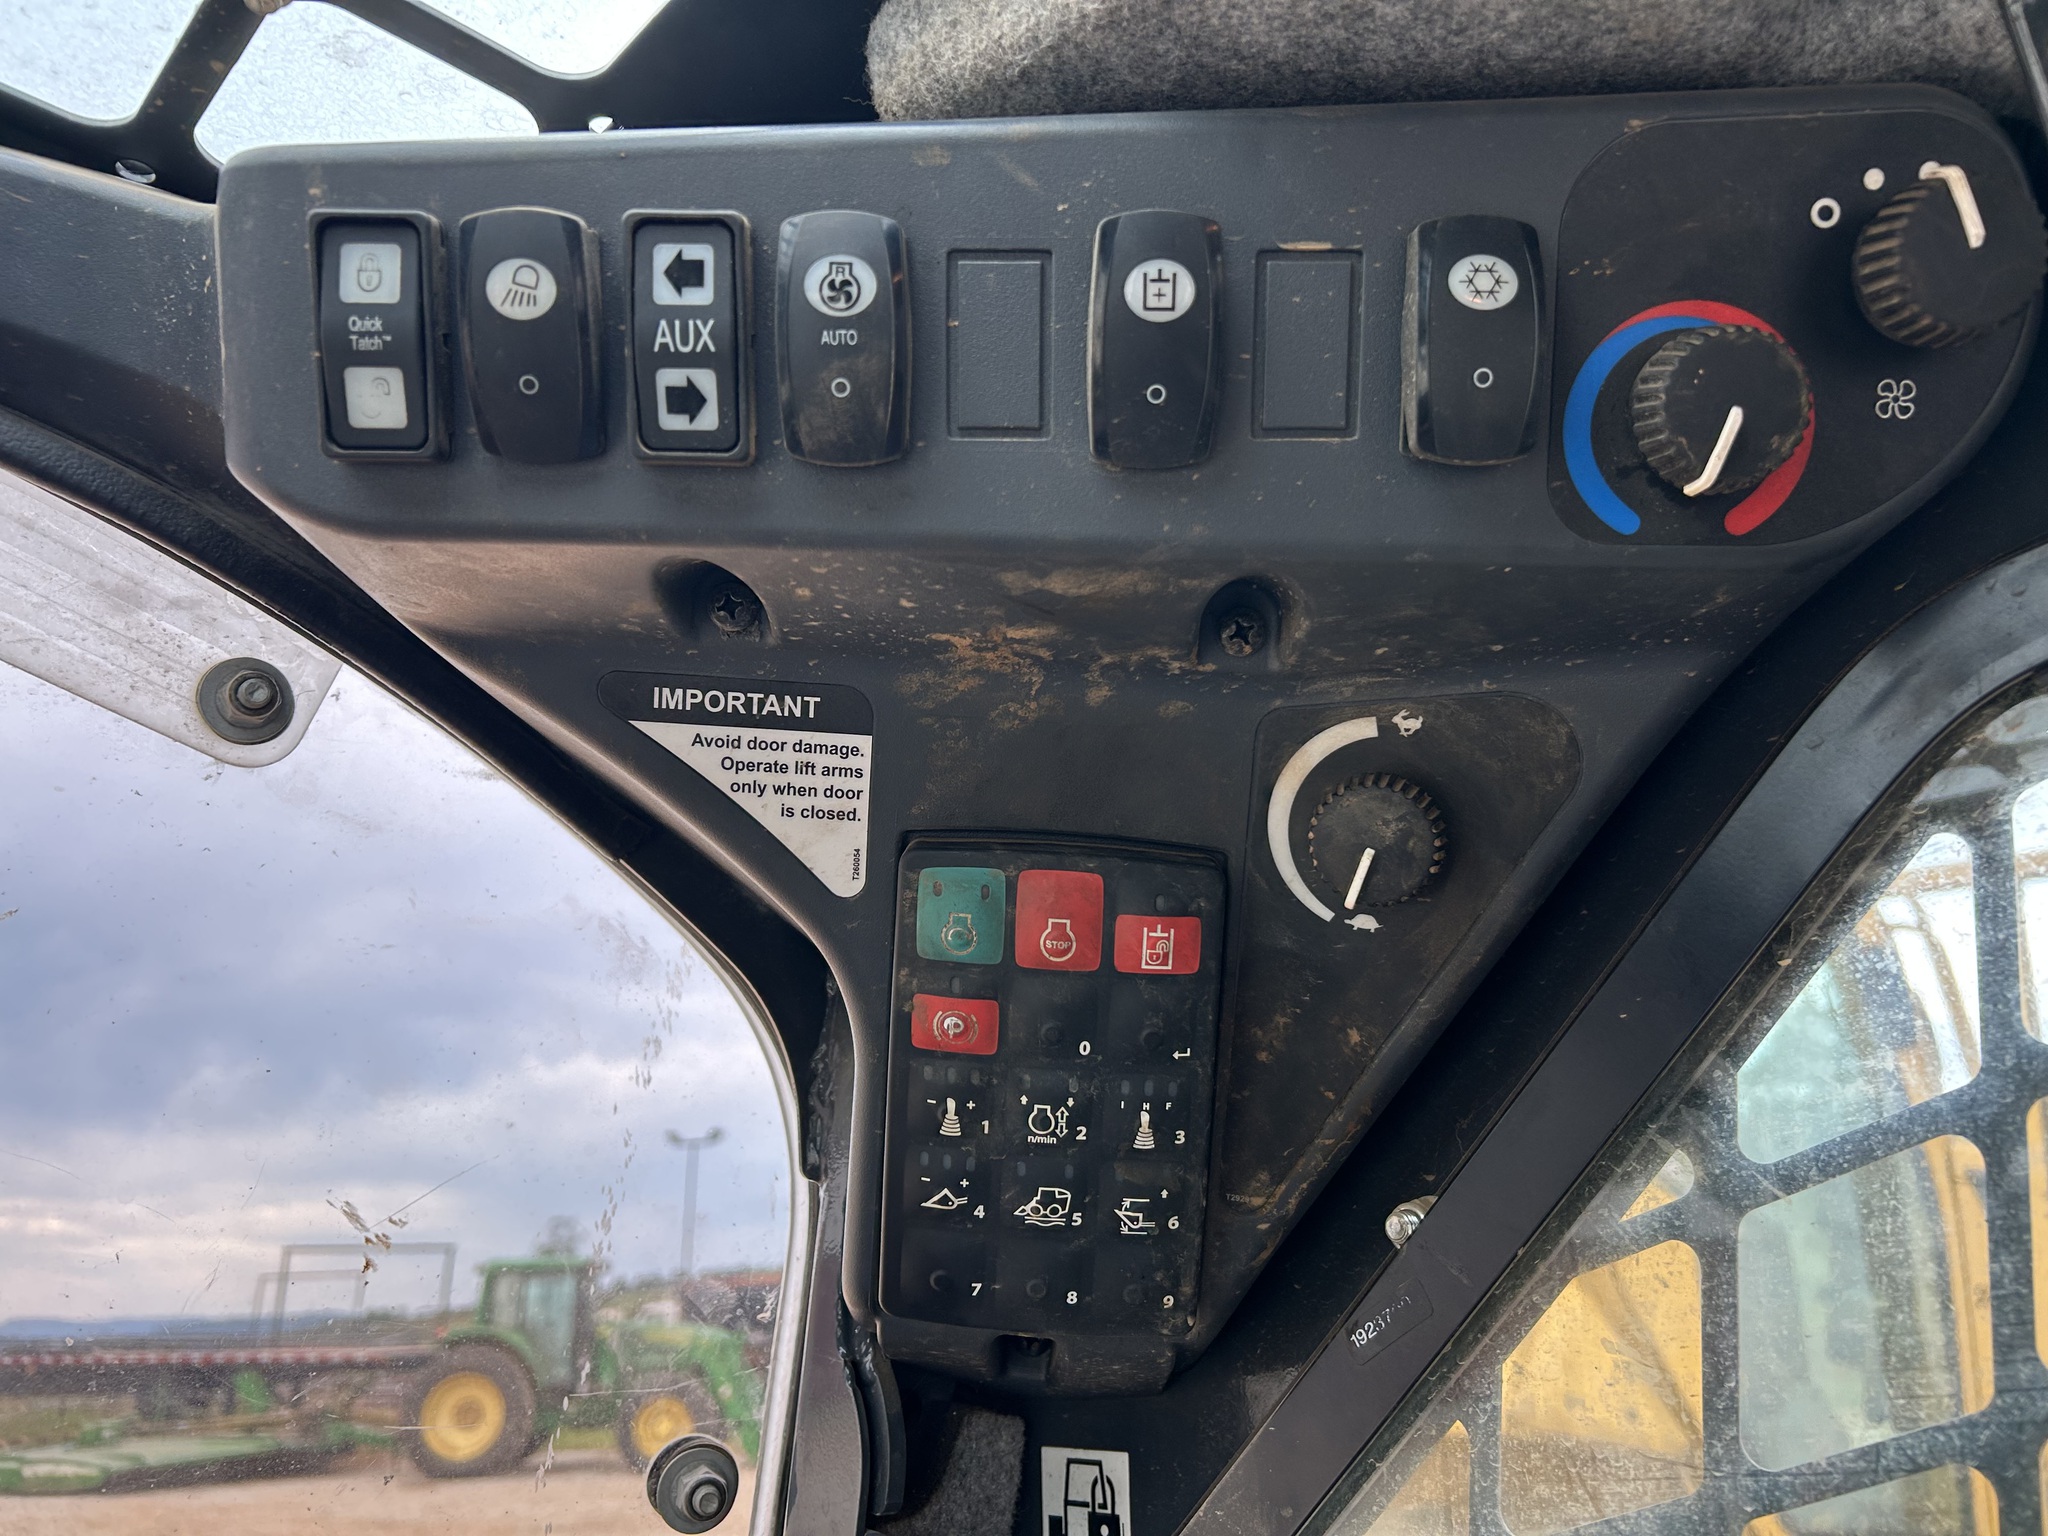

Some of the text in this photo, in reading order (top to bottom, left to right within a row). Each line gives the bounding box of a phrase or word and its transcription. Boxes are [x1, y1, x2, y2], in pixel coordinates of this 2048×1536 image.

[348, 315, 383, 332] Quick
[653, 319, 716, 353] AUX
[820, 329, 858, 346] AUTO
[652, 686, 821, 719] IMPORTANT
[690, 732, 865, 760] Avoid door damage.
[720, 756, 864, 779] Operate lift arms
[730, 780, 864, 801] only when door
[780, 804, 862, 823] is closed.
[852, 848, 861, 881] T260054
[1045, 939, 1072, 950] STOP
[1079, 1041, 1091, 1056] 0
[1142, 1102, 1150, 1111] H
[1165, 1102, 1172, 1111] F
[981, 1120, 989, 1134] 1
[1075, 1126, 1087, 1141] 2
[1027, 1134, 1057, 1145] n/min
[1174, 1130, 1186, 1145] 3
[973, 1205, 985, 1219] 4
[1071, 1213, 1082, 1226] 5
[1167, 1215, 1180, 1230] 6
[971, 1282, 982, 1296] 7
[1066, 1291, 1078, 1305] 8
[1162, 1295, 1174, 1308] 9
